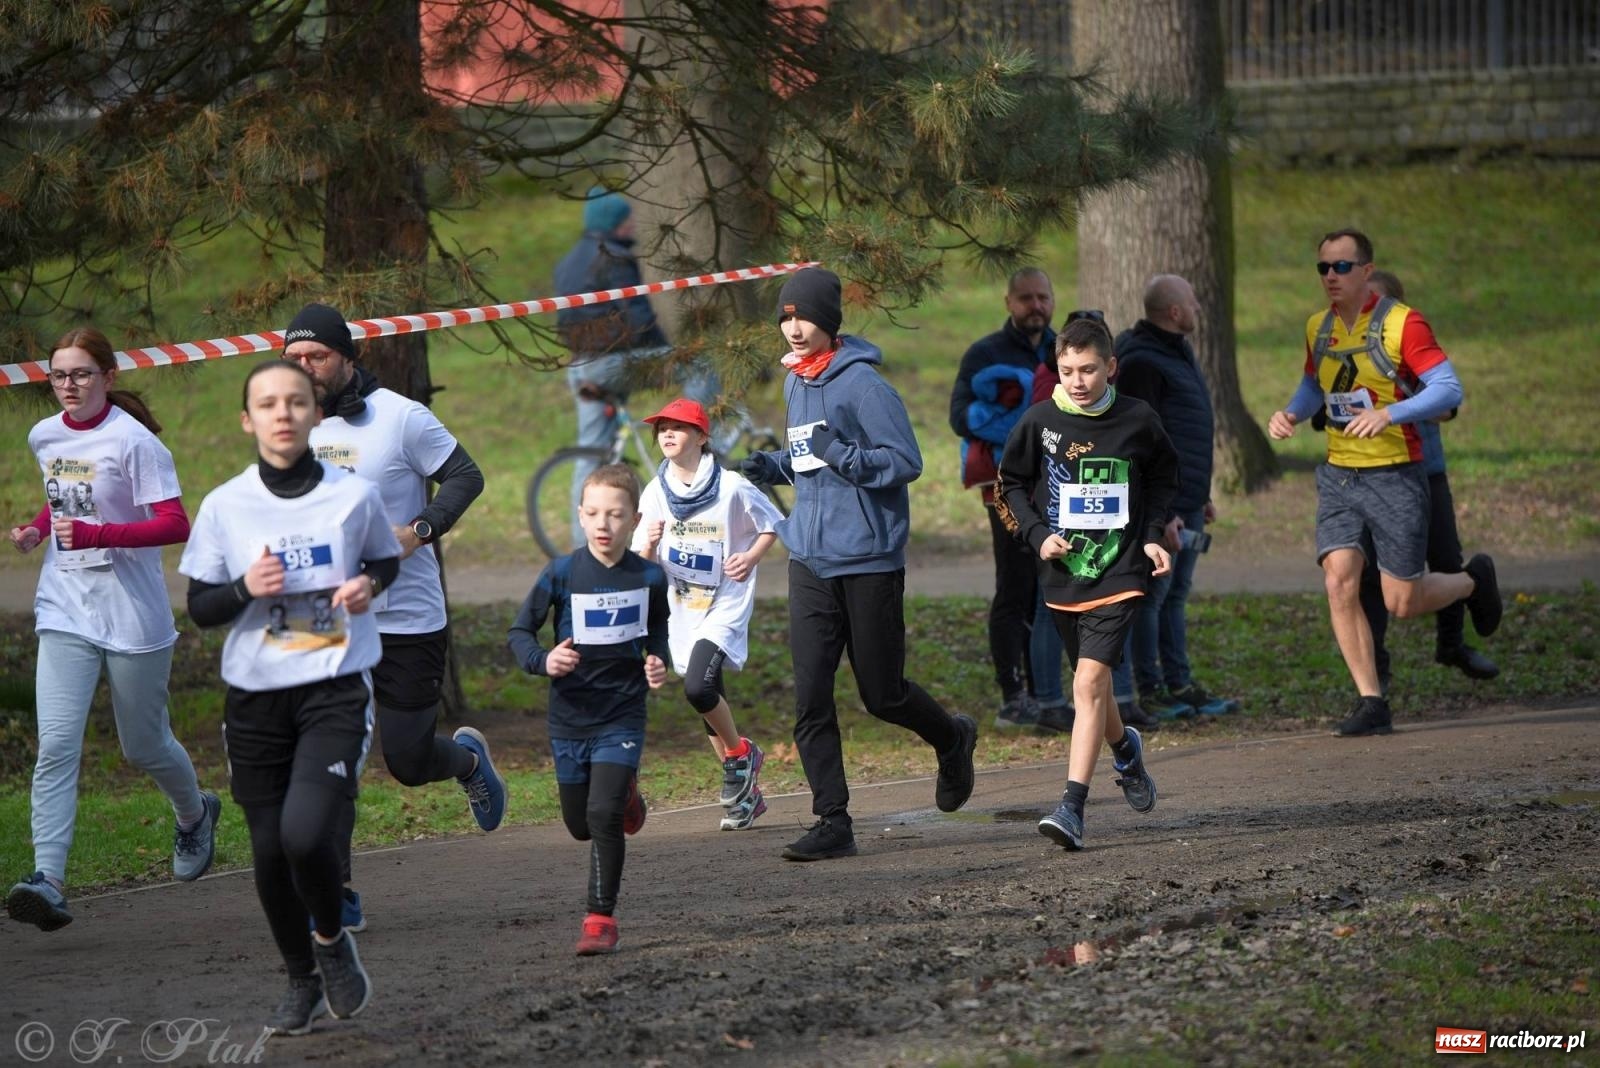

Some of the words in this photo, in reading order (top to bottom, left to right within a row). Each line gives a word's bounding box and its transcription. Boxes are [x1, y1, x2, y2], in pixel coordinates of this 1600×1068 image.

[792, 440, 809, 456] 53
[1083, 498, 1105, 513] 55
[284, 547, 314, 570] 98
[678, 552, 698, 569] 91
[606, 608, 619, 626] 7
